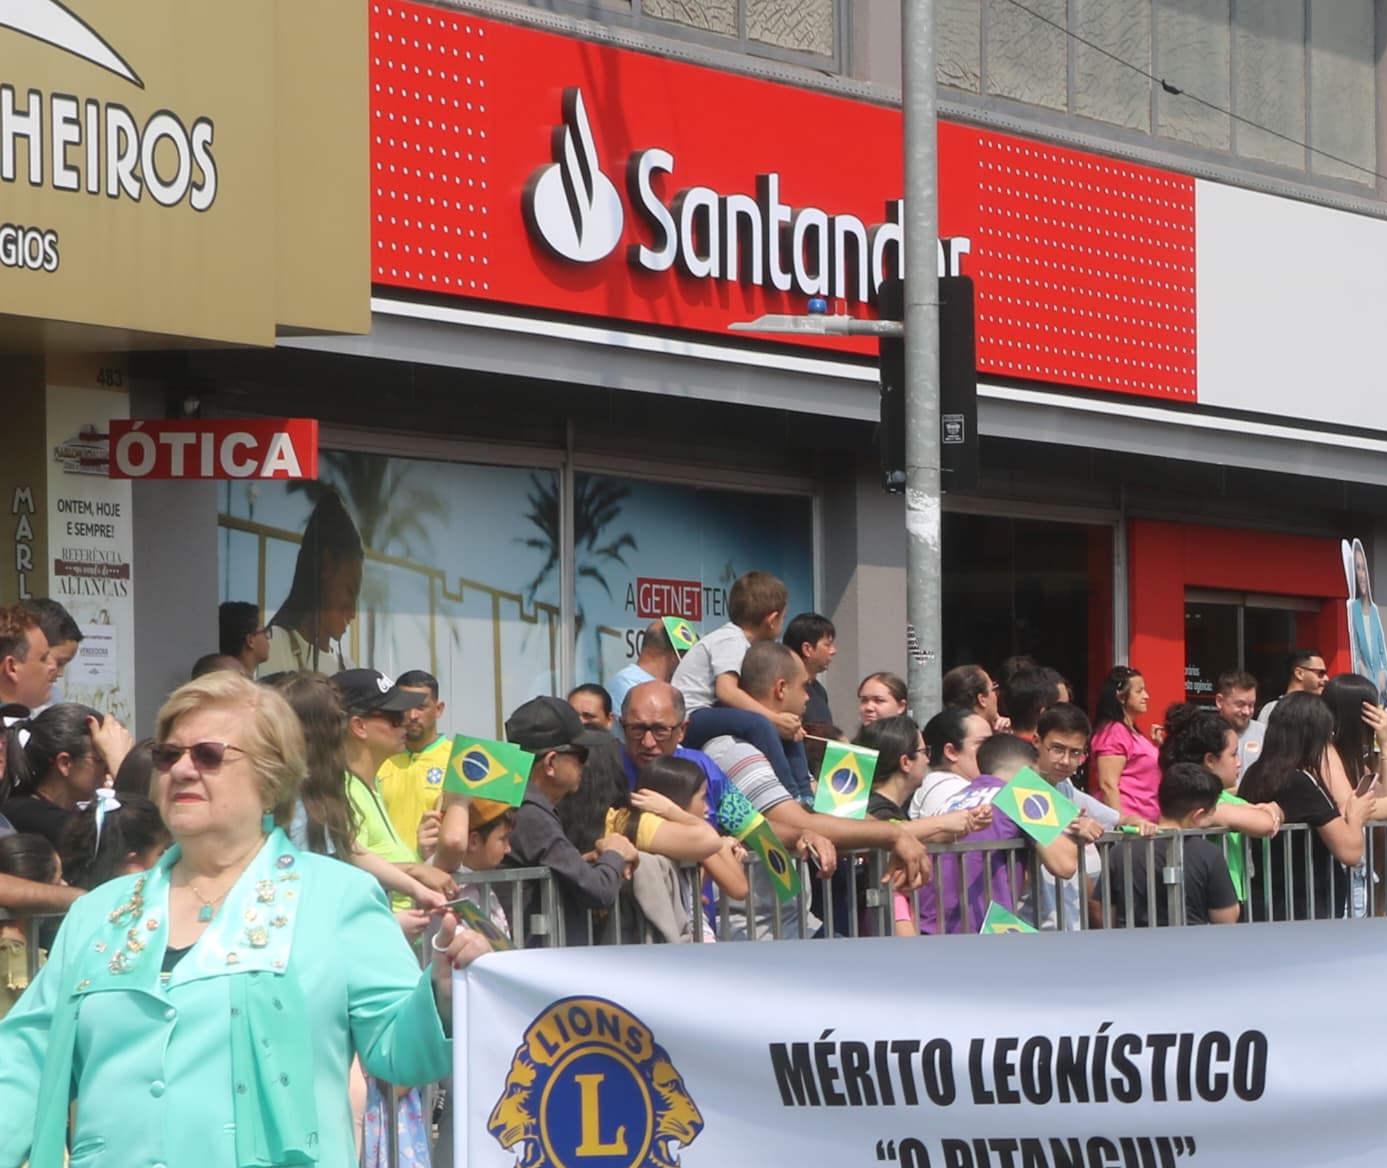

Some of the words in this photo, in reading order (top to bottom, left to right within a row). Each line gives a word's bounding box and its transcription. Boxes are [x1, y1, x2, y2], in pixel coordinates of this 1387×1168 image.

[0, 83, 218, 212] HEIROS
[0, 222, 59, 272] GIOS
[630, 148, 971, 303] Santandr
[115, 420, 302, 478] ÓTICA
[57, 498, 94, 515] ONTEM,
[96, 502, 121, 518] HOJE
[74, 522, 115, 539] SEMPRE!
[62, 547, 122, 563] REFERÊNCIA
[625, 583, 636, 611] A
[639, 583, 700, 616] GETNET
[535, 1005, 644, 1057] LIONS
[768, 1028, 957, 1107] MÉRITO
[967, 1021, 1269, 1106] LEONÍSTICO
[574, 1073, 629, 1156] L
